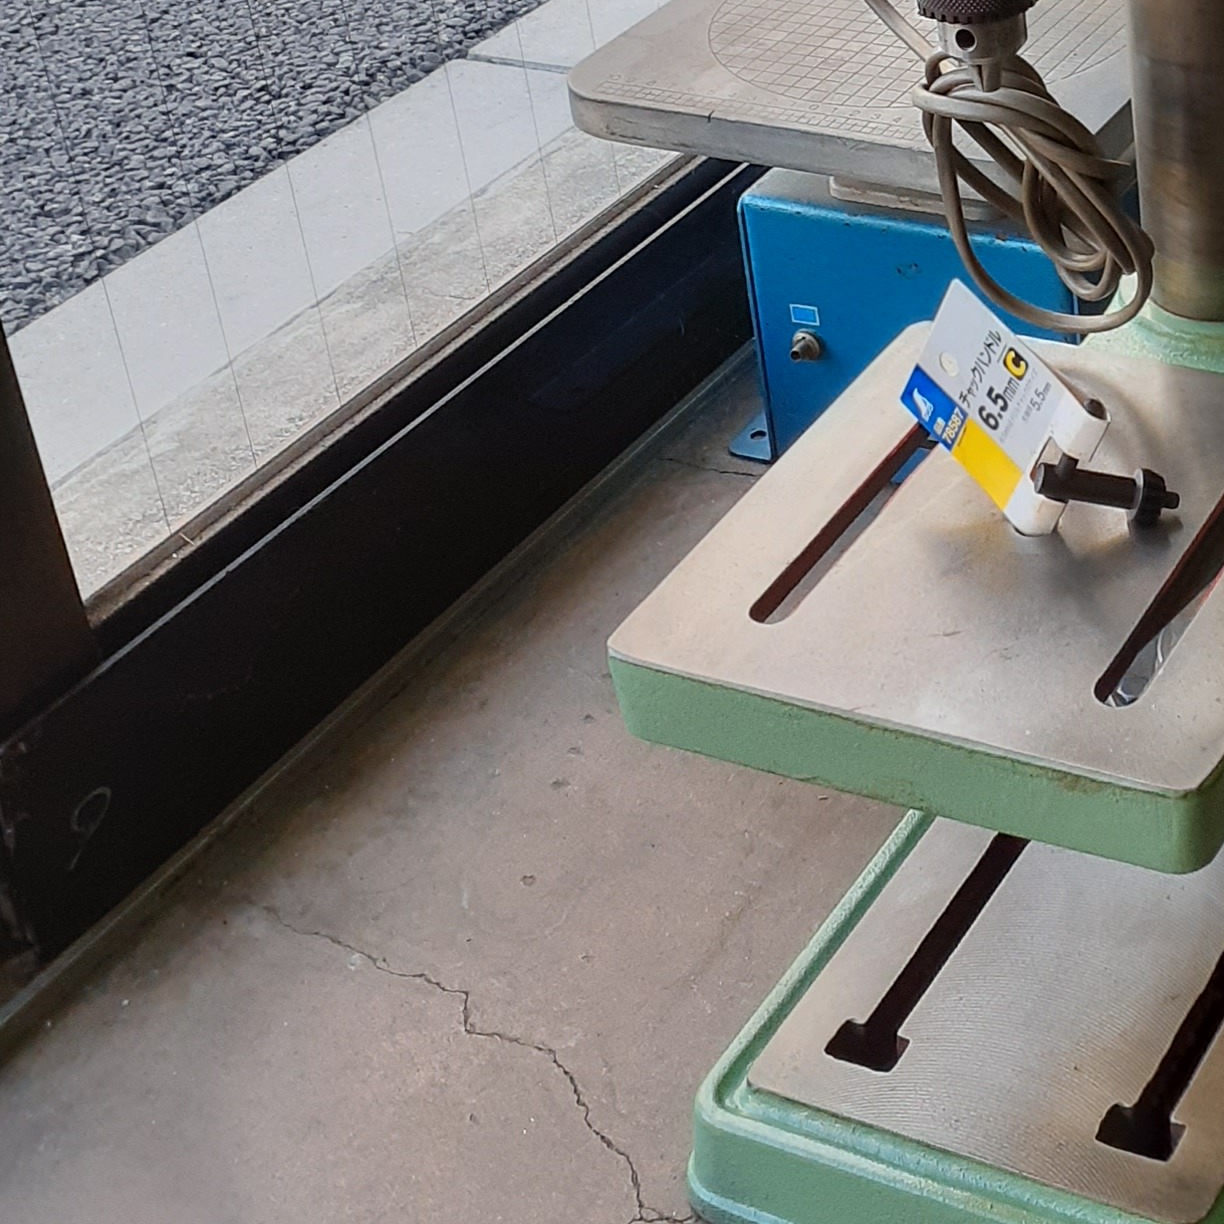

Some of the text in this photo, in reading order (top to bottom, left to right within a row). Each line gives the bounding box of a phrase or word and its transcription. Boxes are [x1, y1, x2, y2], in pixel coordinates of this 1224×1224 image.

[958, 329, 1003, 409] チャックハンドル
[1004, 349, 1028, 378] C
[941, 406, 965, 445] 78587
